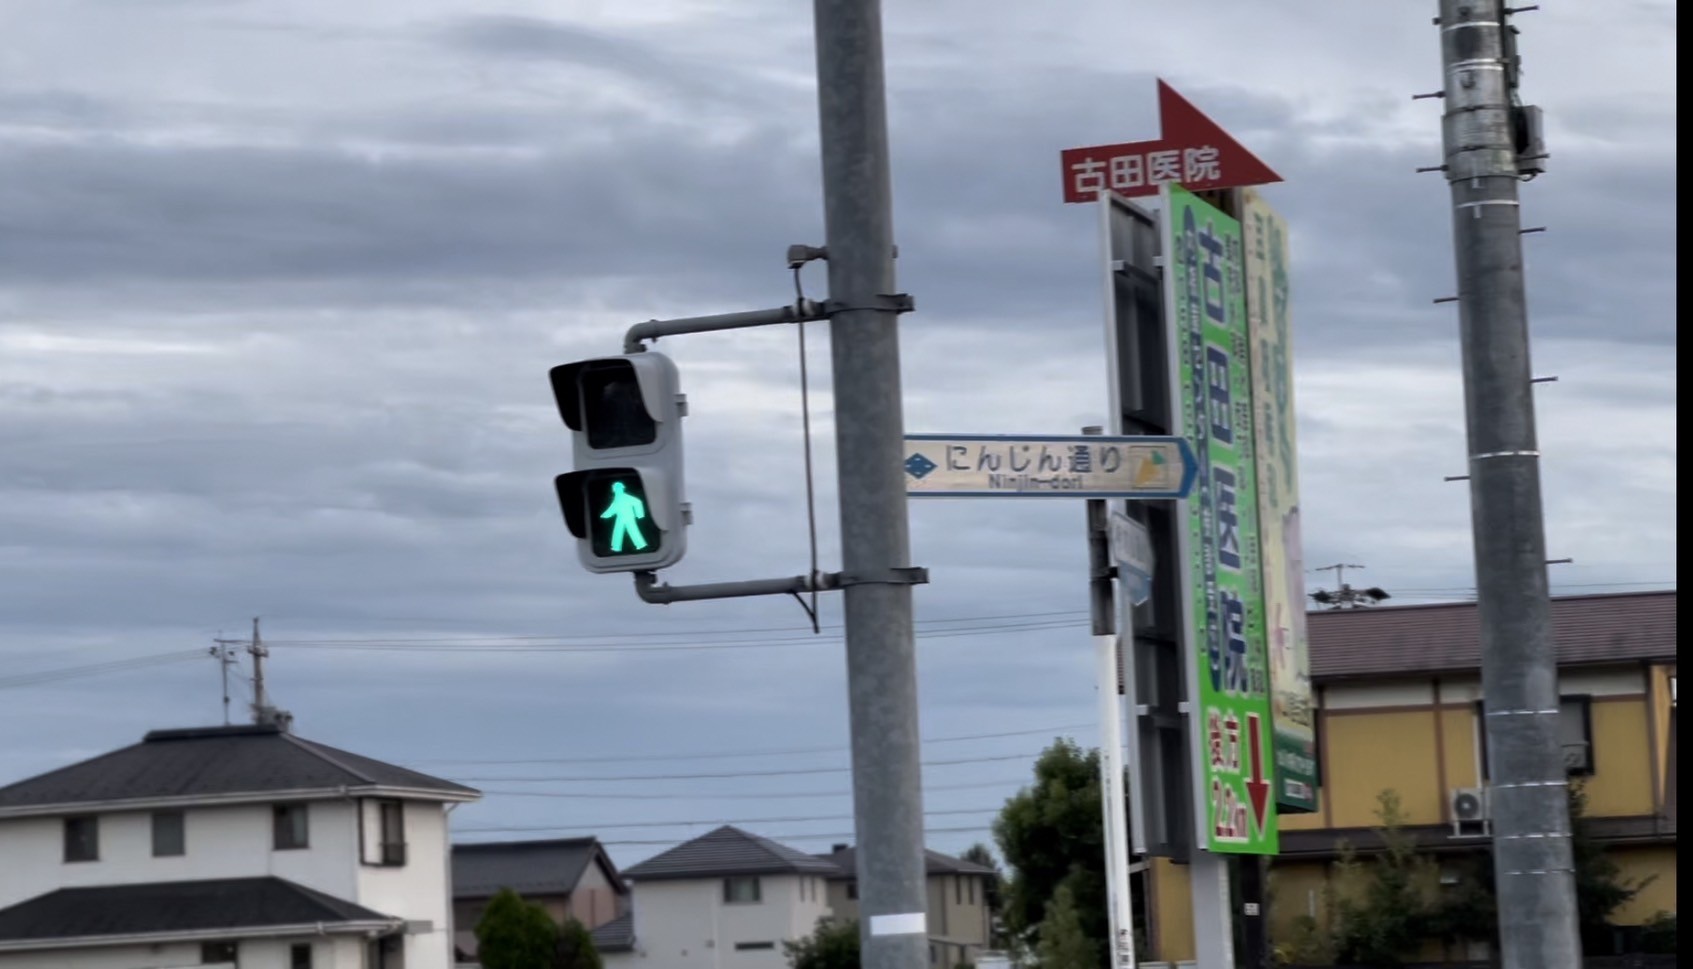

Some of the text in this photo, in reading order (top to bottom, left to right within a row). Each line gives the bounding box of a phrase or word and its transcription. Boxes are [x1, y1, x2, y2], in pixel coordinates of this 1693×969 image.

[1071, 146, 1221, 193] 古田医院
[945, 444, 1122, 473] にんじん通り
[1199, 218, 1249, 693] 古田医院
[988, 473, 1084, 491] Ninjin-dori
